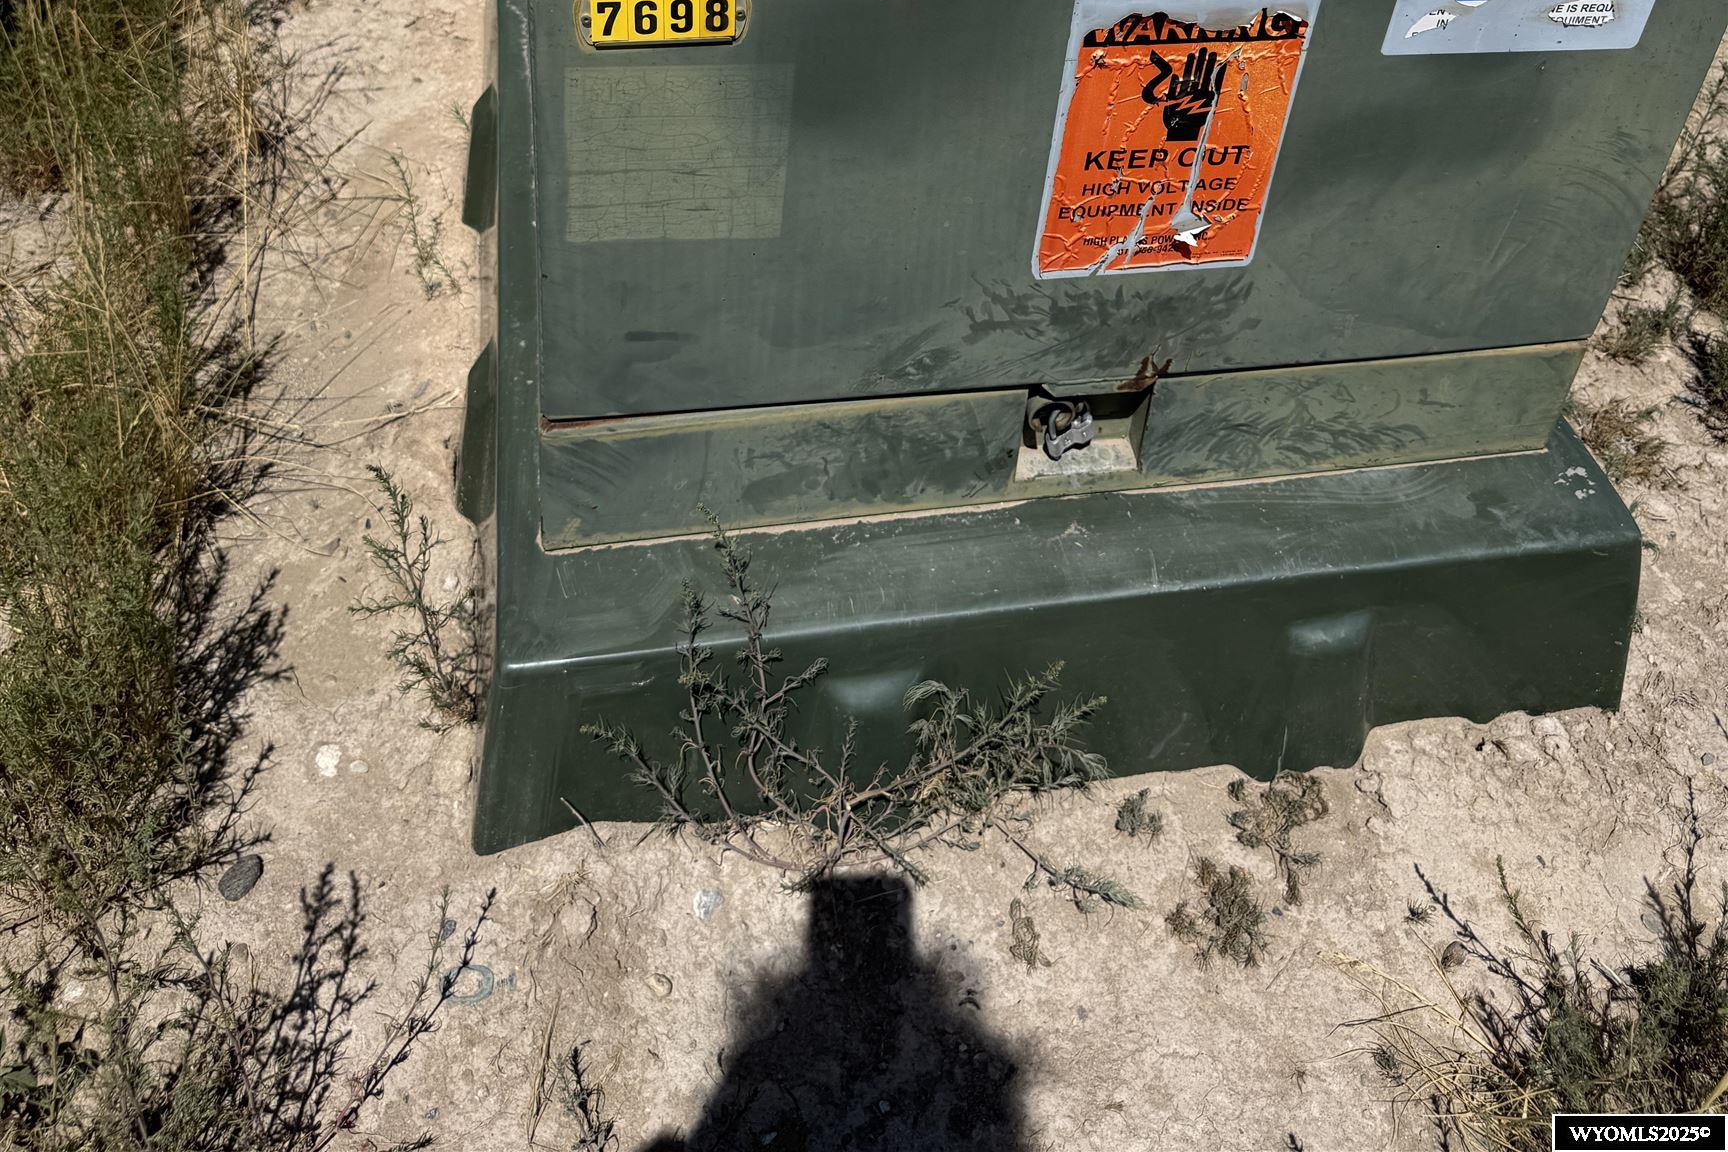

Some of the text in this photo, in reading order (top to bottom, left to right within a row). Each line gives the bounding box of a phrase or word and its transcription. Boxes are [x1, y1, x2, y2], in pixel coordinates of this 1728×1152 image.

[1566, 4, 1578, 12] IS
[1580, 3, 1614, 12] REQU
[1084, 145, 1250, 171] KEEP OUT
[1081, 177, 1238, 196] HIGH VOLTAGE
[1058, 198, 1250, 220] EQUIPMENT NSIDE
[1083, 236, 1107, 246] HIGH
